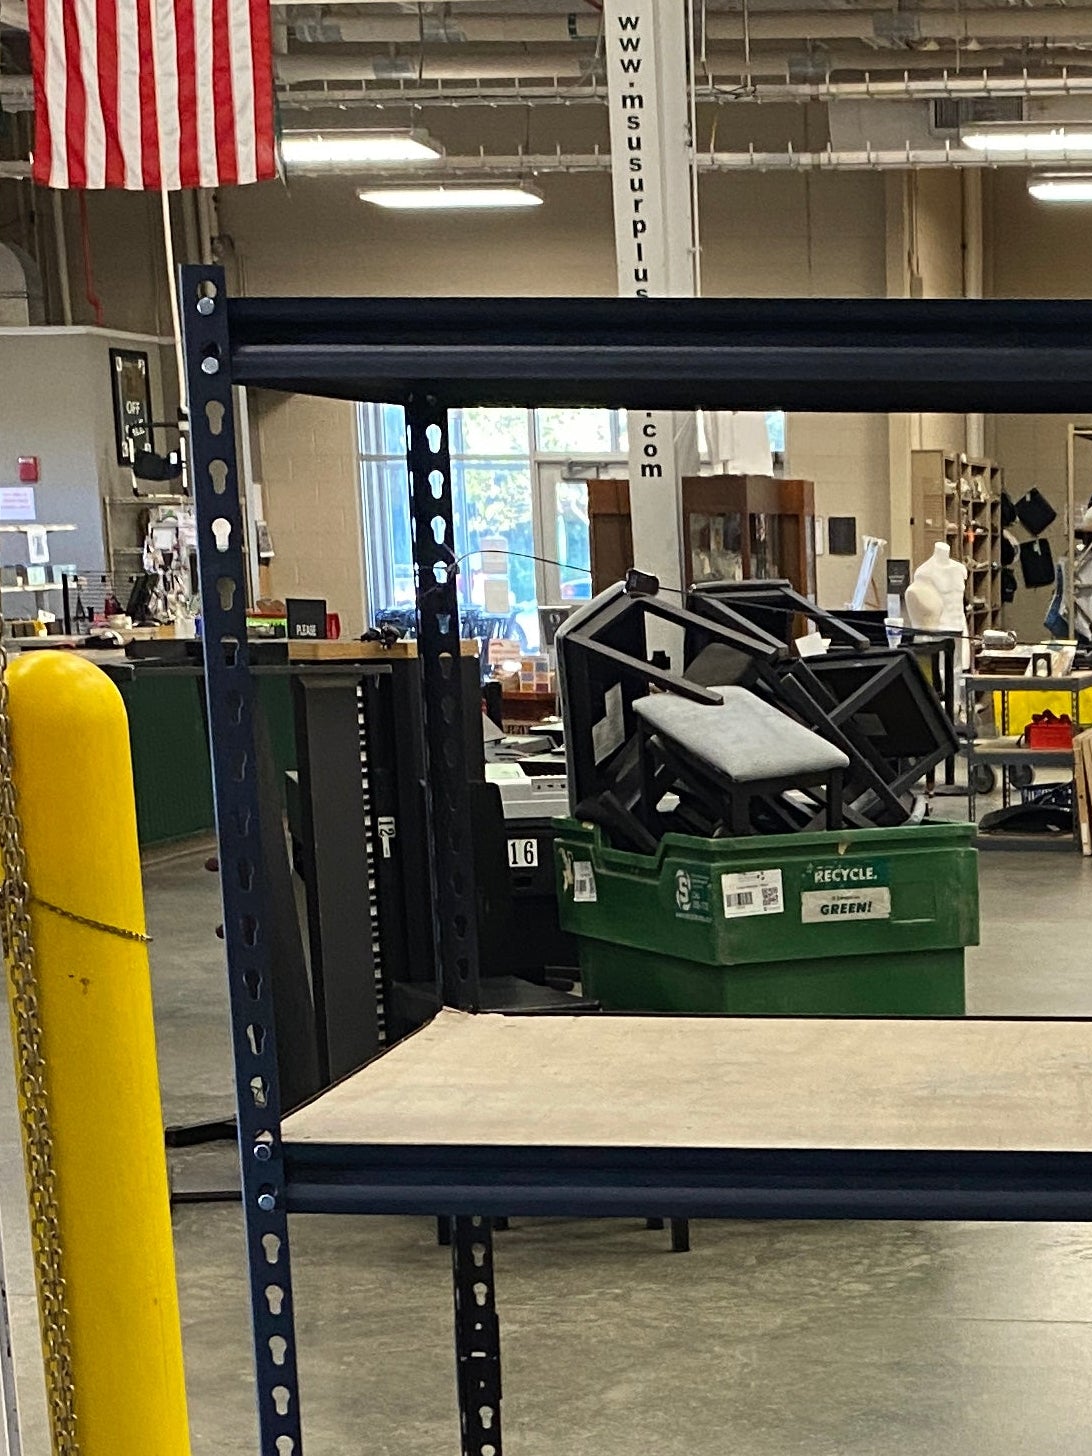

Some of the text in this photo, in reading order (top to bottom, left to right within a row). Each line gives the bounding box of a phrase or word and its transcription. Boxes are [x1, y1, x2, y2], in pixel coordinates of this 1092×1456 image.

[510, 841, 534, 865] 16
[814, 866, 878, 883] RECYCLE.
[820, 901, 873, 916] GREEN!
